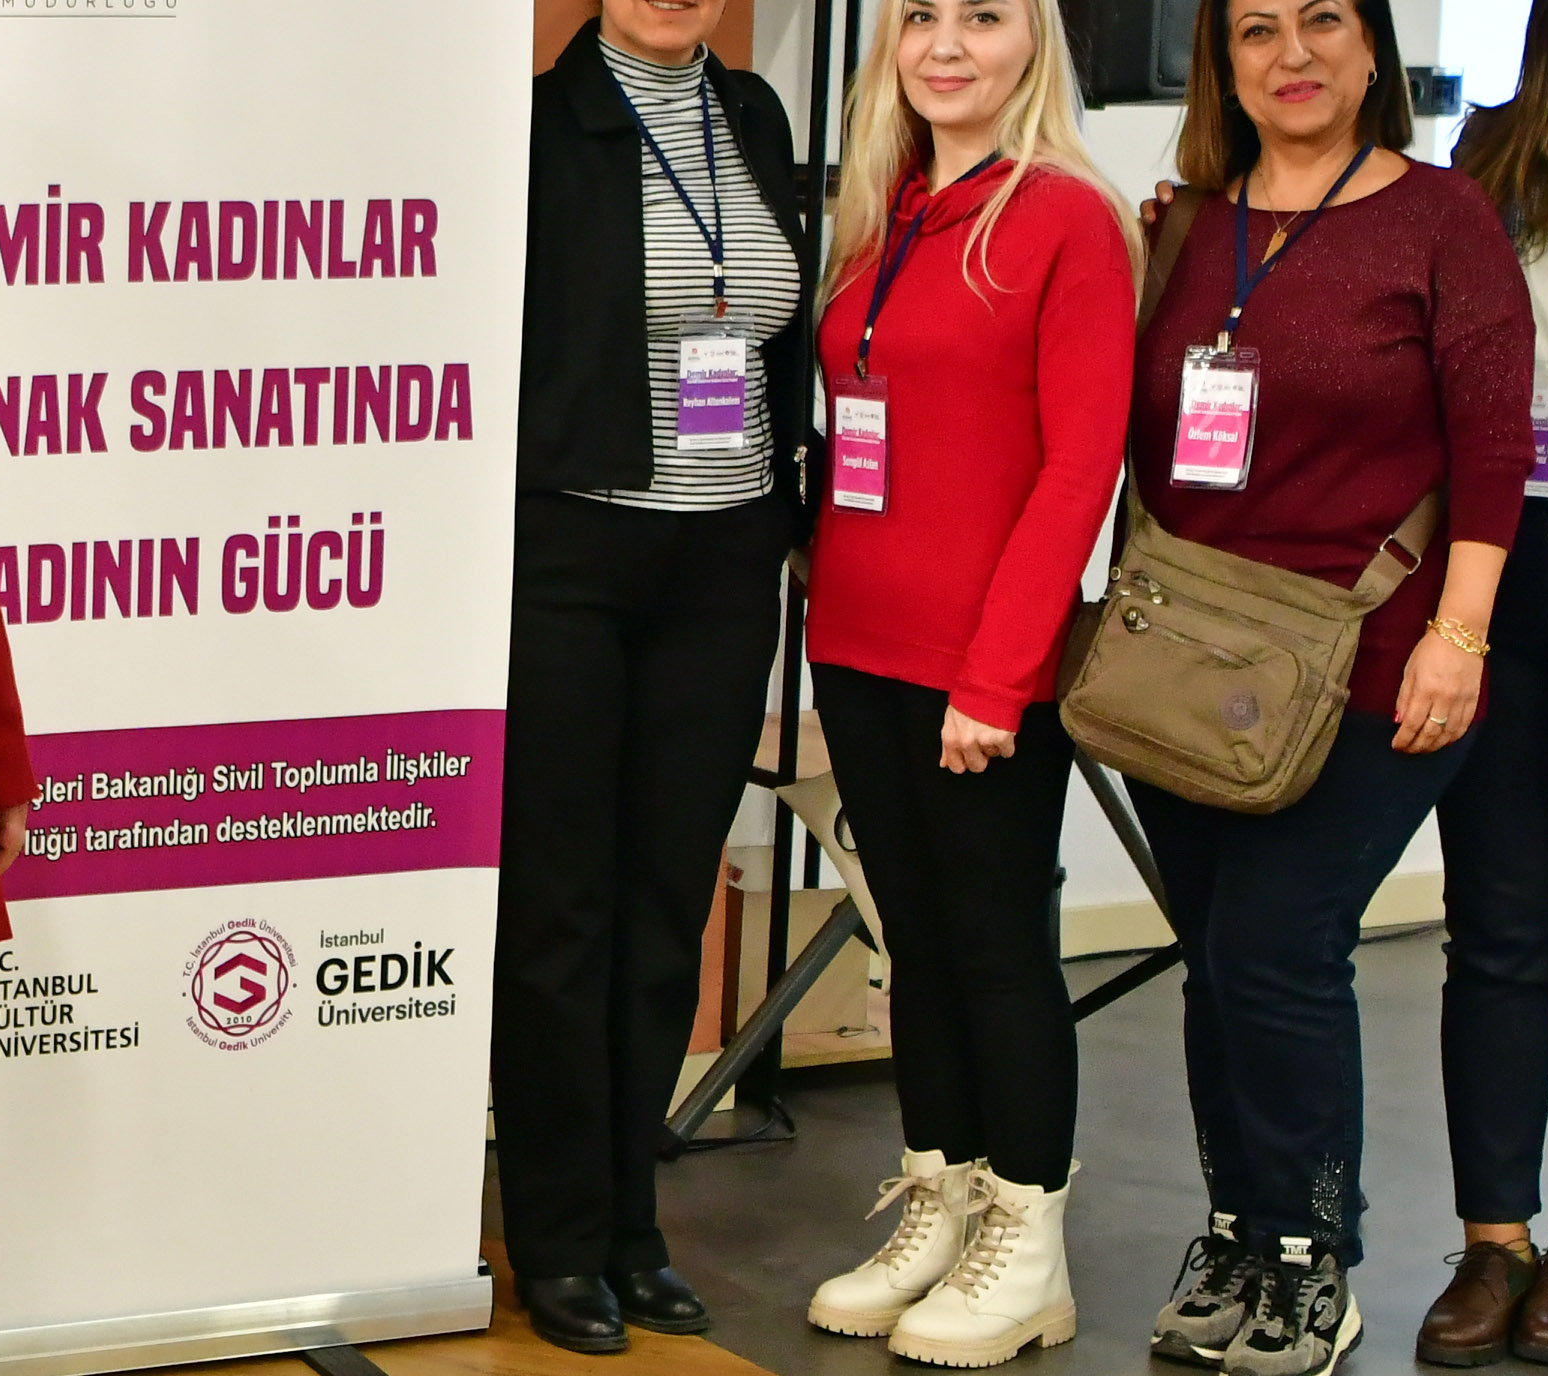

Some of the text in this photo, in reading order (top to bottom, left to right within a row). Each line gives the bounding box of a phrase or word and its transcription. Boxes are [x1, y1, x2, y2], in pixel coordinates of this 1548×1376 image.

[126, 198, 438, 282] KADINLAR
[129, 361, 474, 453] SANATINDA
[221, 511, 385, 614] GÜCÜ
[31, 748, 471, 811] şleri Bakanlığı Sivil Toplumla İlişkiler
[85, 819, 209, 851] tarafından
[216, 802, 436, 843] desteklenmektedir.
[227, 918, 257, 930] Gedik
[259, 920, 299, 967] Üniversitesi
[320, 928, 385, 948] İstanbul
[316, 941, 455, 996] GEDİK
[219, 1040, 249, 1051] Gedik
[250, 1008, 293, 1047] University
[226, 1015, 252, 1025] 2010
[318, 993, 456, 1027] Üniversitesi
[1284, 1245, 1309, 1255] TMT
